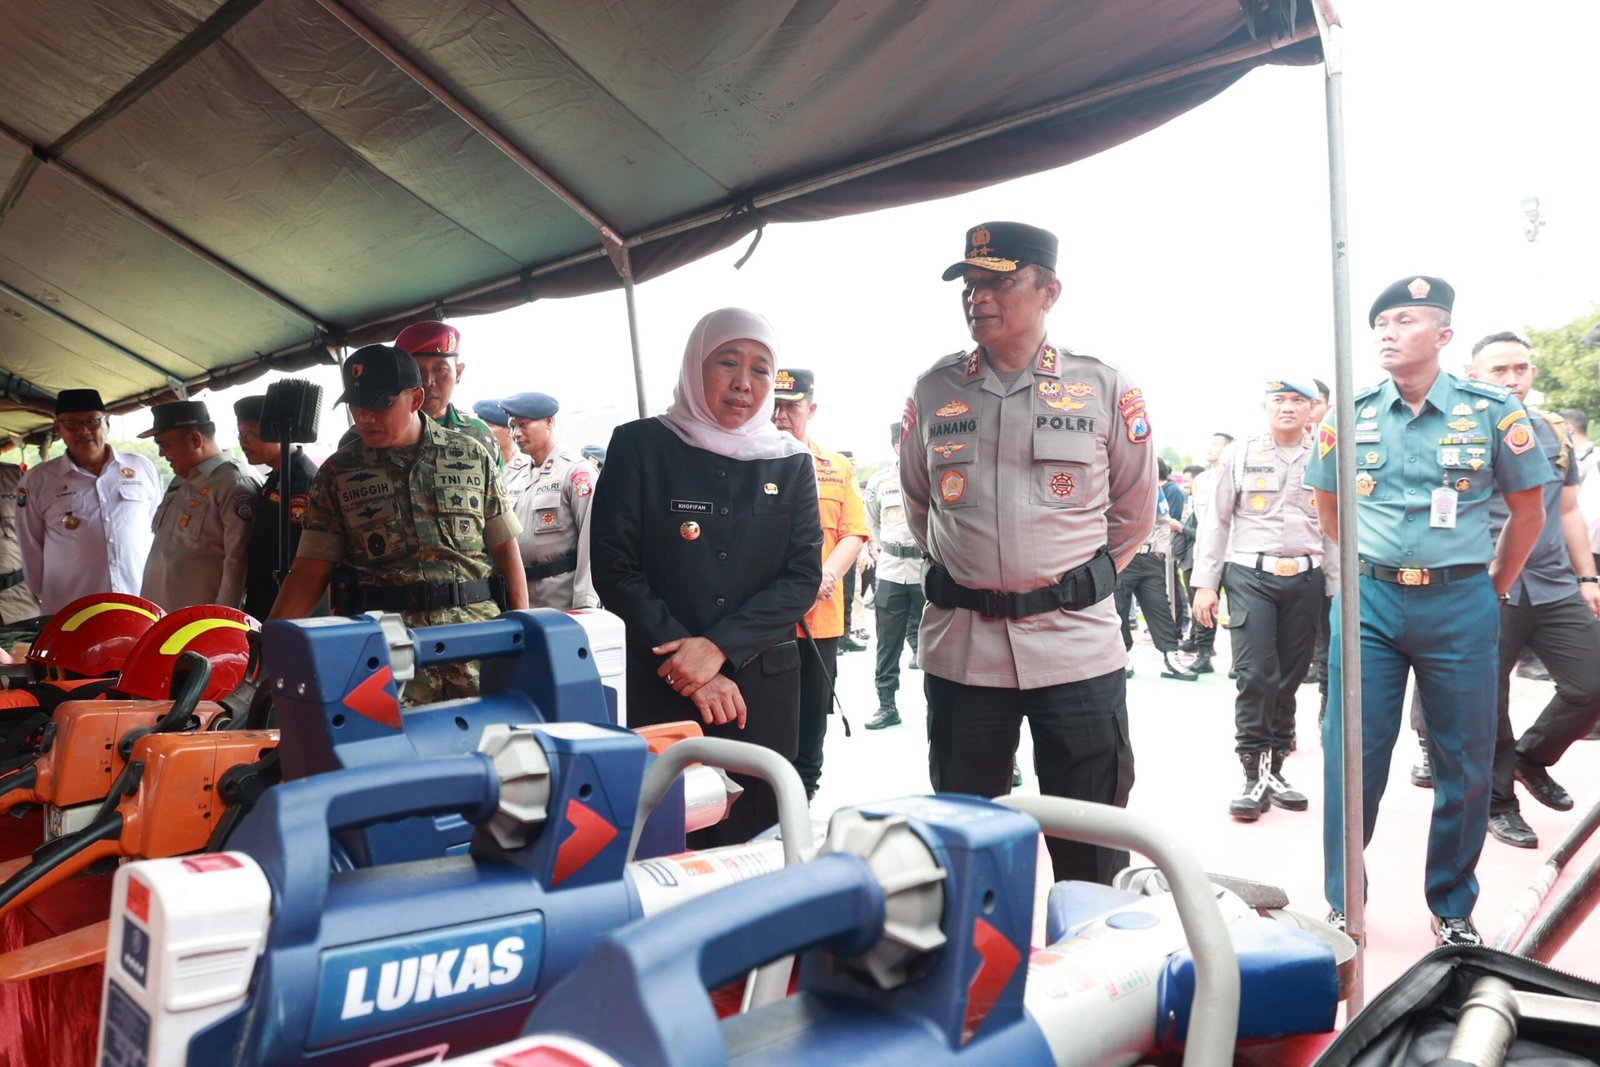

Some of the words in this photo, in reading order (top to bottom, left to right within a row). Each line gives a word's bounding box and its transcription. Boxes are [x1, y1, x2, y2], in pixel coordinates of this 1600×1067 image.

[929, 420, 977, 438] NANANG
[1036, 416, 1094, 432] POLRI
[440, 475, 460, 485] TNI
[466, 476, 481, 486] AD
[537, 482, 560, 494] POLRI
[342, 482, 389, 503] SINGGIH
[678, 503, 706, 511] KHOFIFAH
[340, 935, 526, 1020] LUKAS
